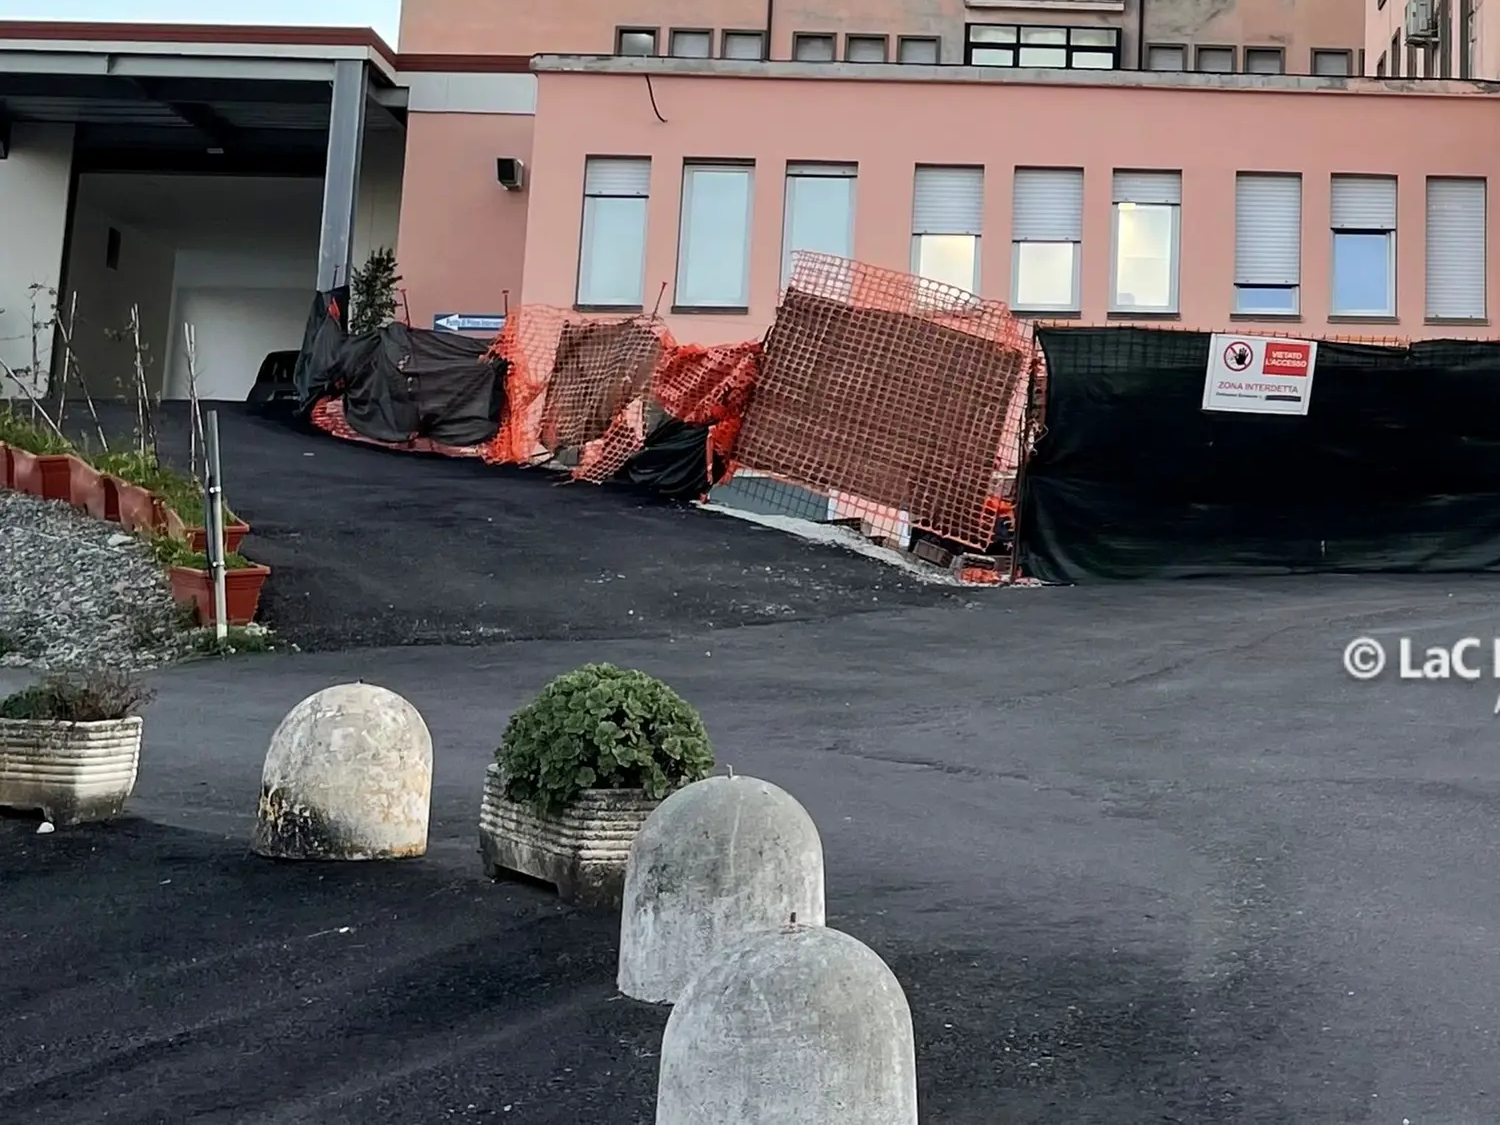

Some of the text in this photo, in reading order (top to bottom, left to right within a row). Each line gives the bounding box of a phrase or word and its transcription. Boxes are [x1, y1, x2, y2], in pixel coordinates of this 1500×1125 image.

[1272, 350, 1303, 360] VIETATO
[1265, 358, 1308, 368] L'ACCESSO
[1218, 381, 1299, 394] ZONA INTERDETTA
